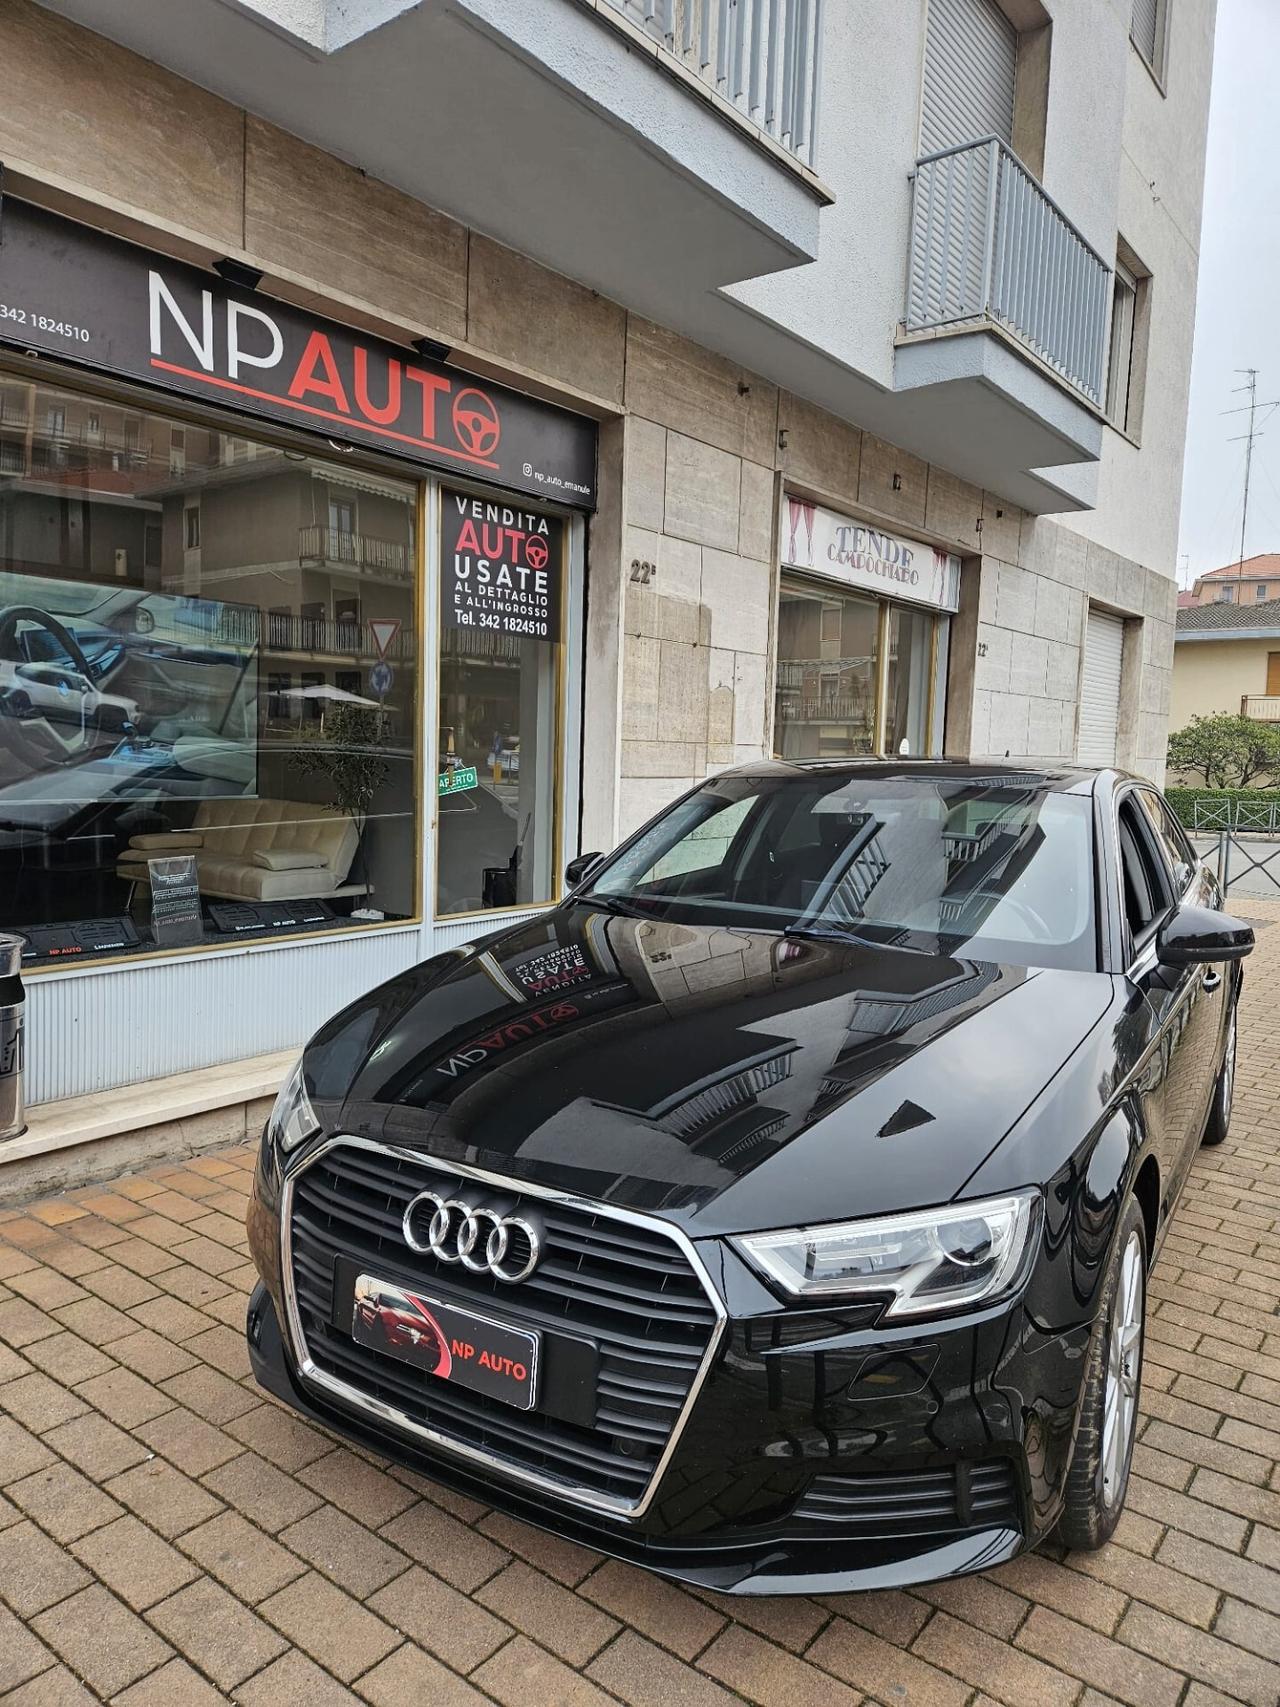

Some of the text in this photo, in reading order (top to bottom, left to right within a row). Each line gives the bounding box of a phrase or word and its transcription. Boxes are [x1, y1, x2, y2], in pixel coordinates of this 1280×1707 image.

[0, 304, 90, 343] 342 1824510
[456, 496, 550, 535] VENDITA
[454, 554, 548, 594] USATE
[454, 594, 548, 618] E ALL'INGROSSO
[455, 581, 548, 607] AL DETTAGLIO
[454, 608, 547, 636] Tel. 342 1824510
[62, 946, 82, 955] AUTO
[451, 1339, 527, 1380] NP AUTO
